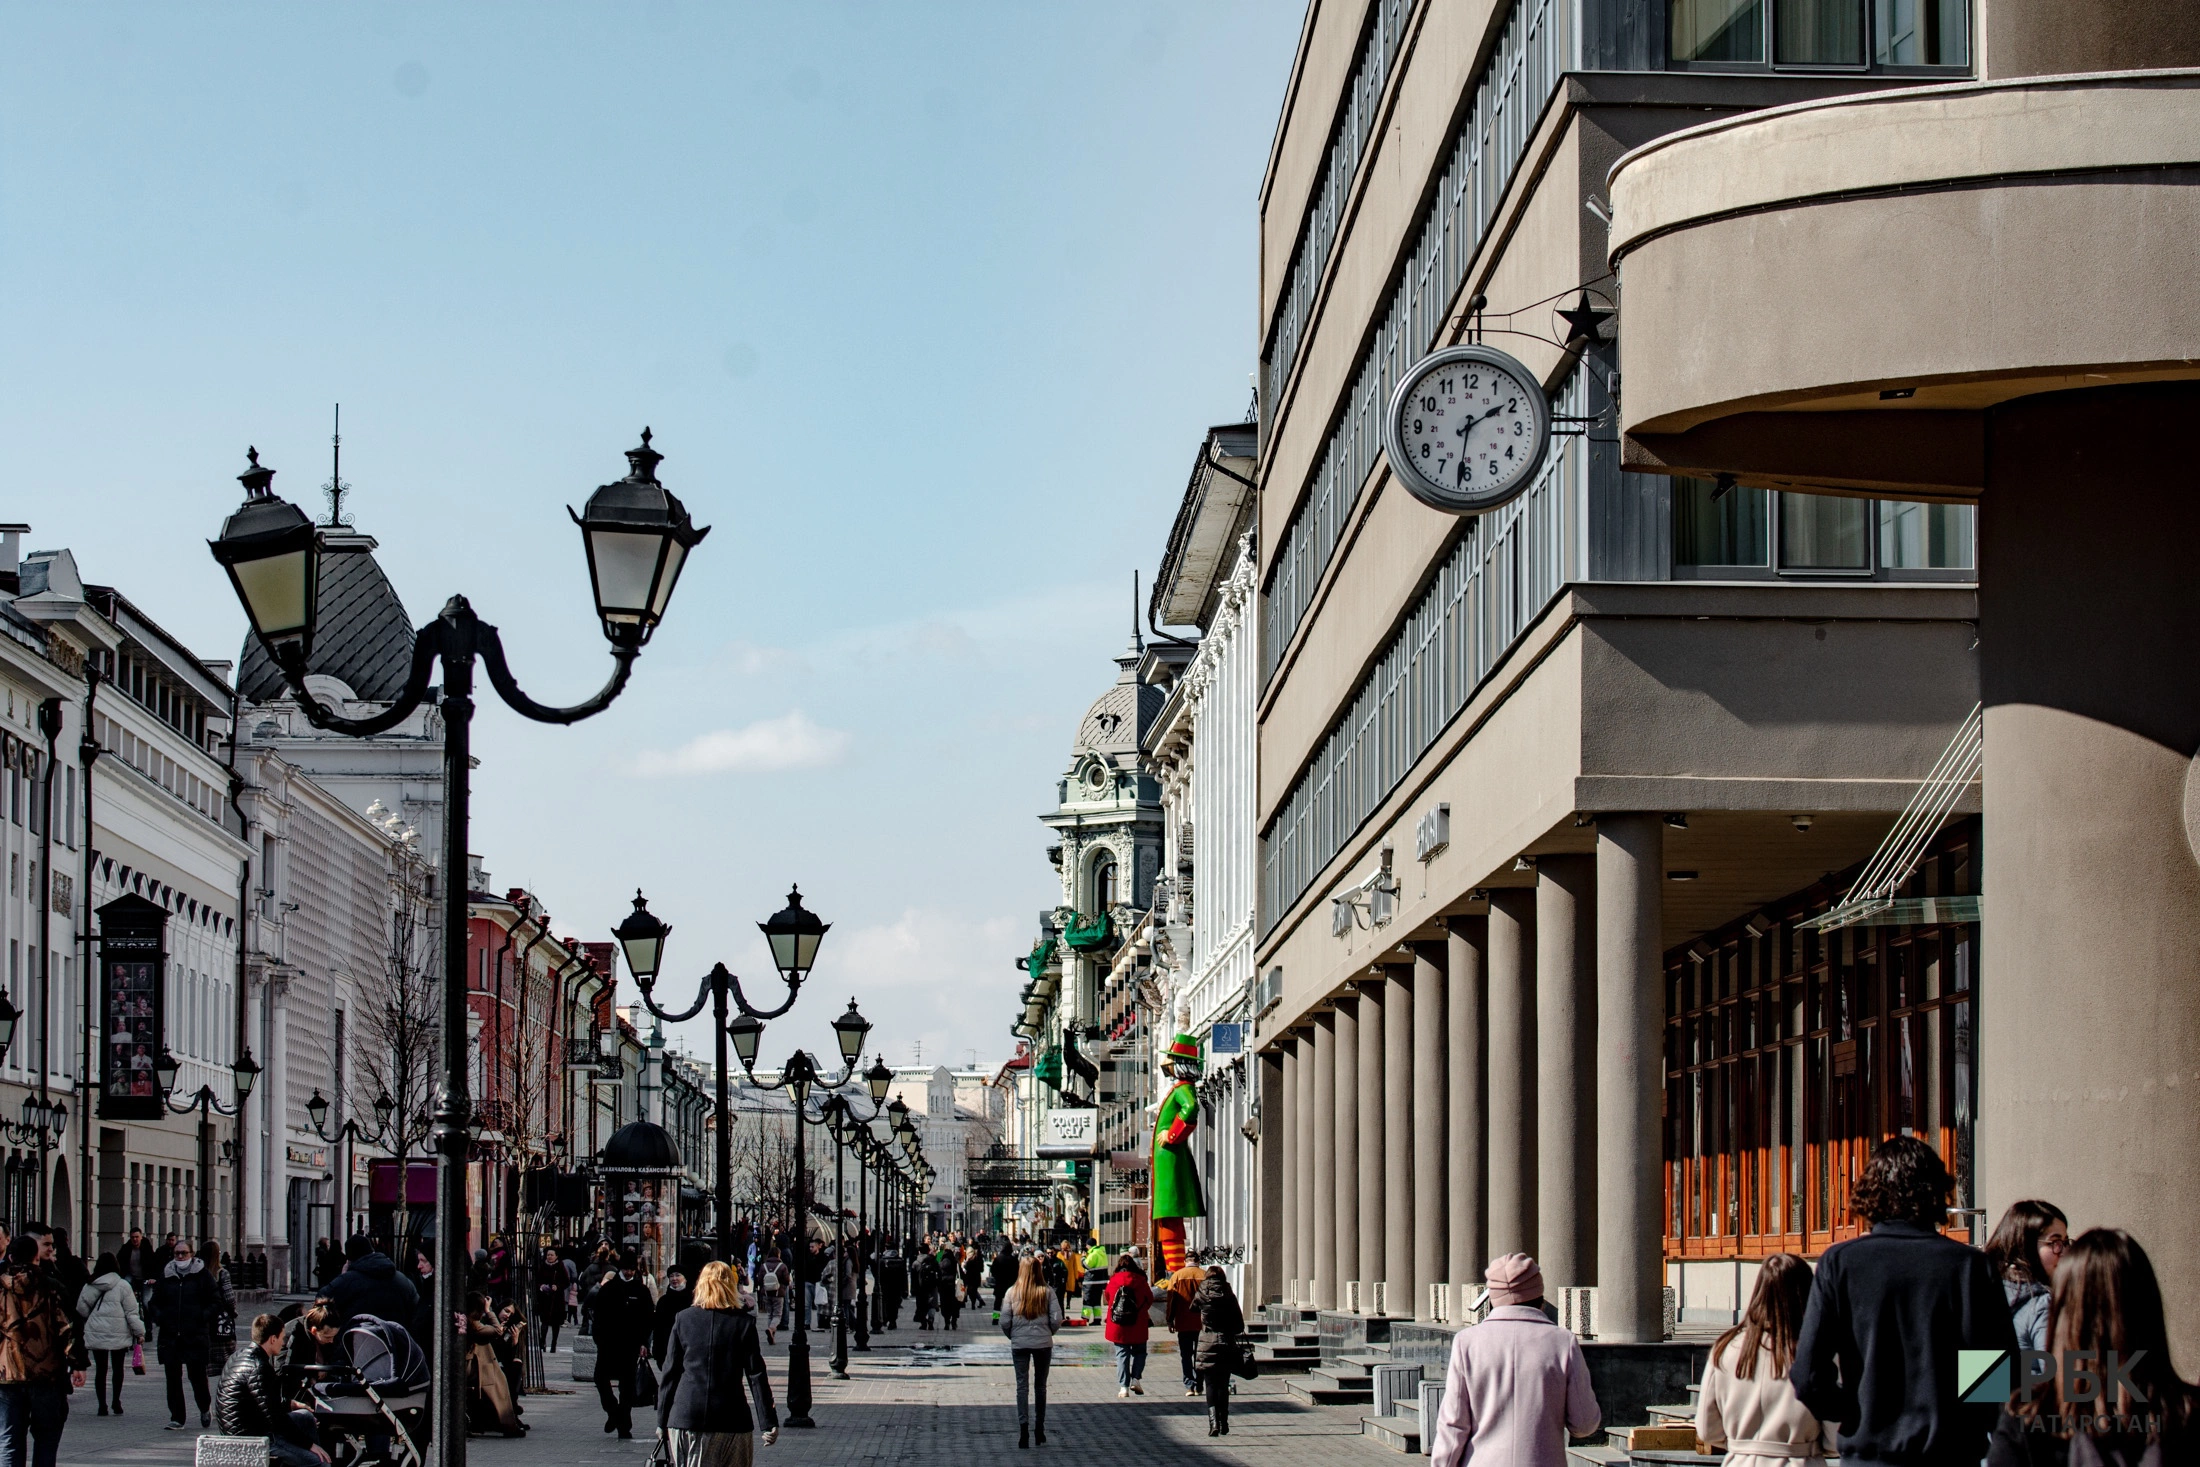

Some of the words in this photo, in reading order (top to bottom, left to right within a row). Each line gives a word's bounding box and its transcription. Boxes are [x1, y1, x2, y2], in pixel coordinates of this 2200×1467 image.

[1439, 379, 1453, 394] 11
[1462, 373, 1479, 390] 12
[1491, 380, 1498, 395] 1
[1420, 396, 1436, 412] 10
[1508, 397, 1517, 413] 2
[1413, 419, 1422, 434] 9
[1514, 421, 1523, 436] 3
[1421, 443, 1430, 458] 8
[1504, 445, 1513, 460] 4
[1437, 459, 1447, 474] 7
[1463, 466, 1472, 482] 6
[1489, 460, 1498, 475] 5
[1051, 1115, 1091, 1127] COYOTE
[1058, 1126, 1084, 1138] UGLY
